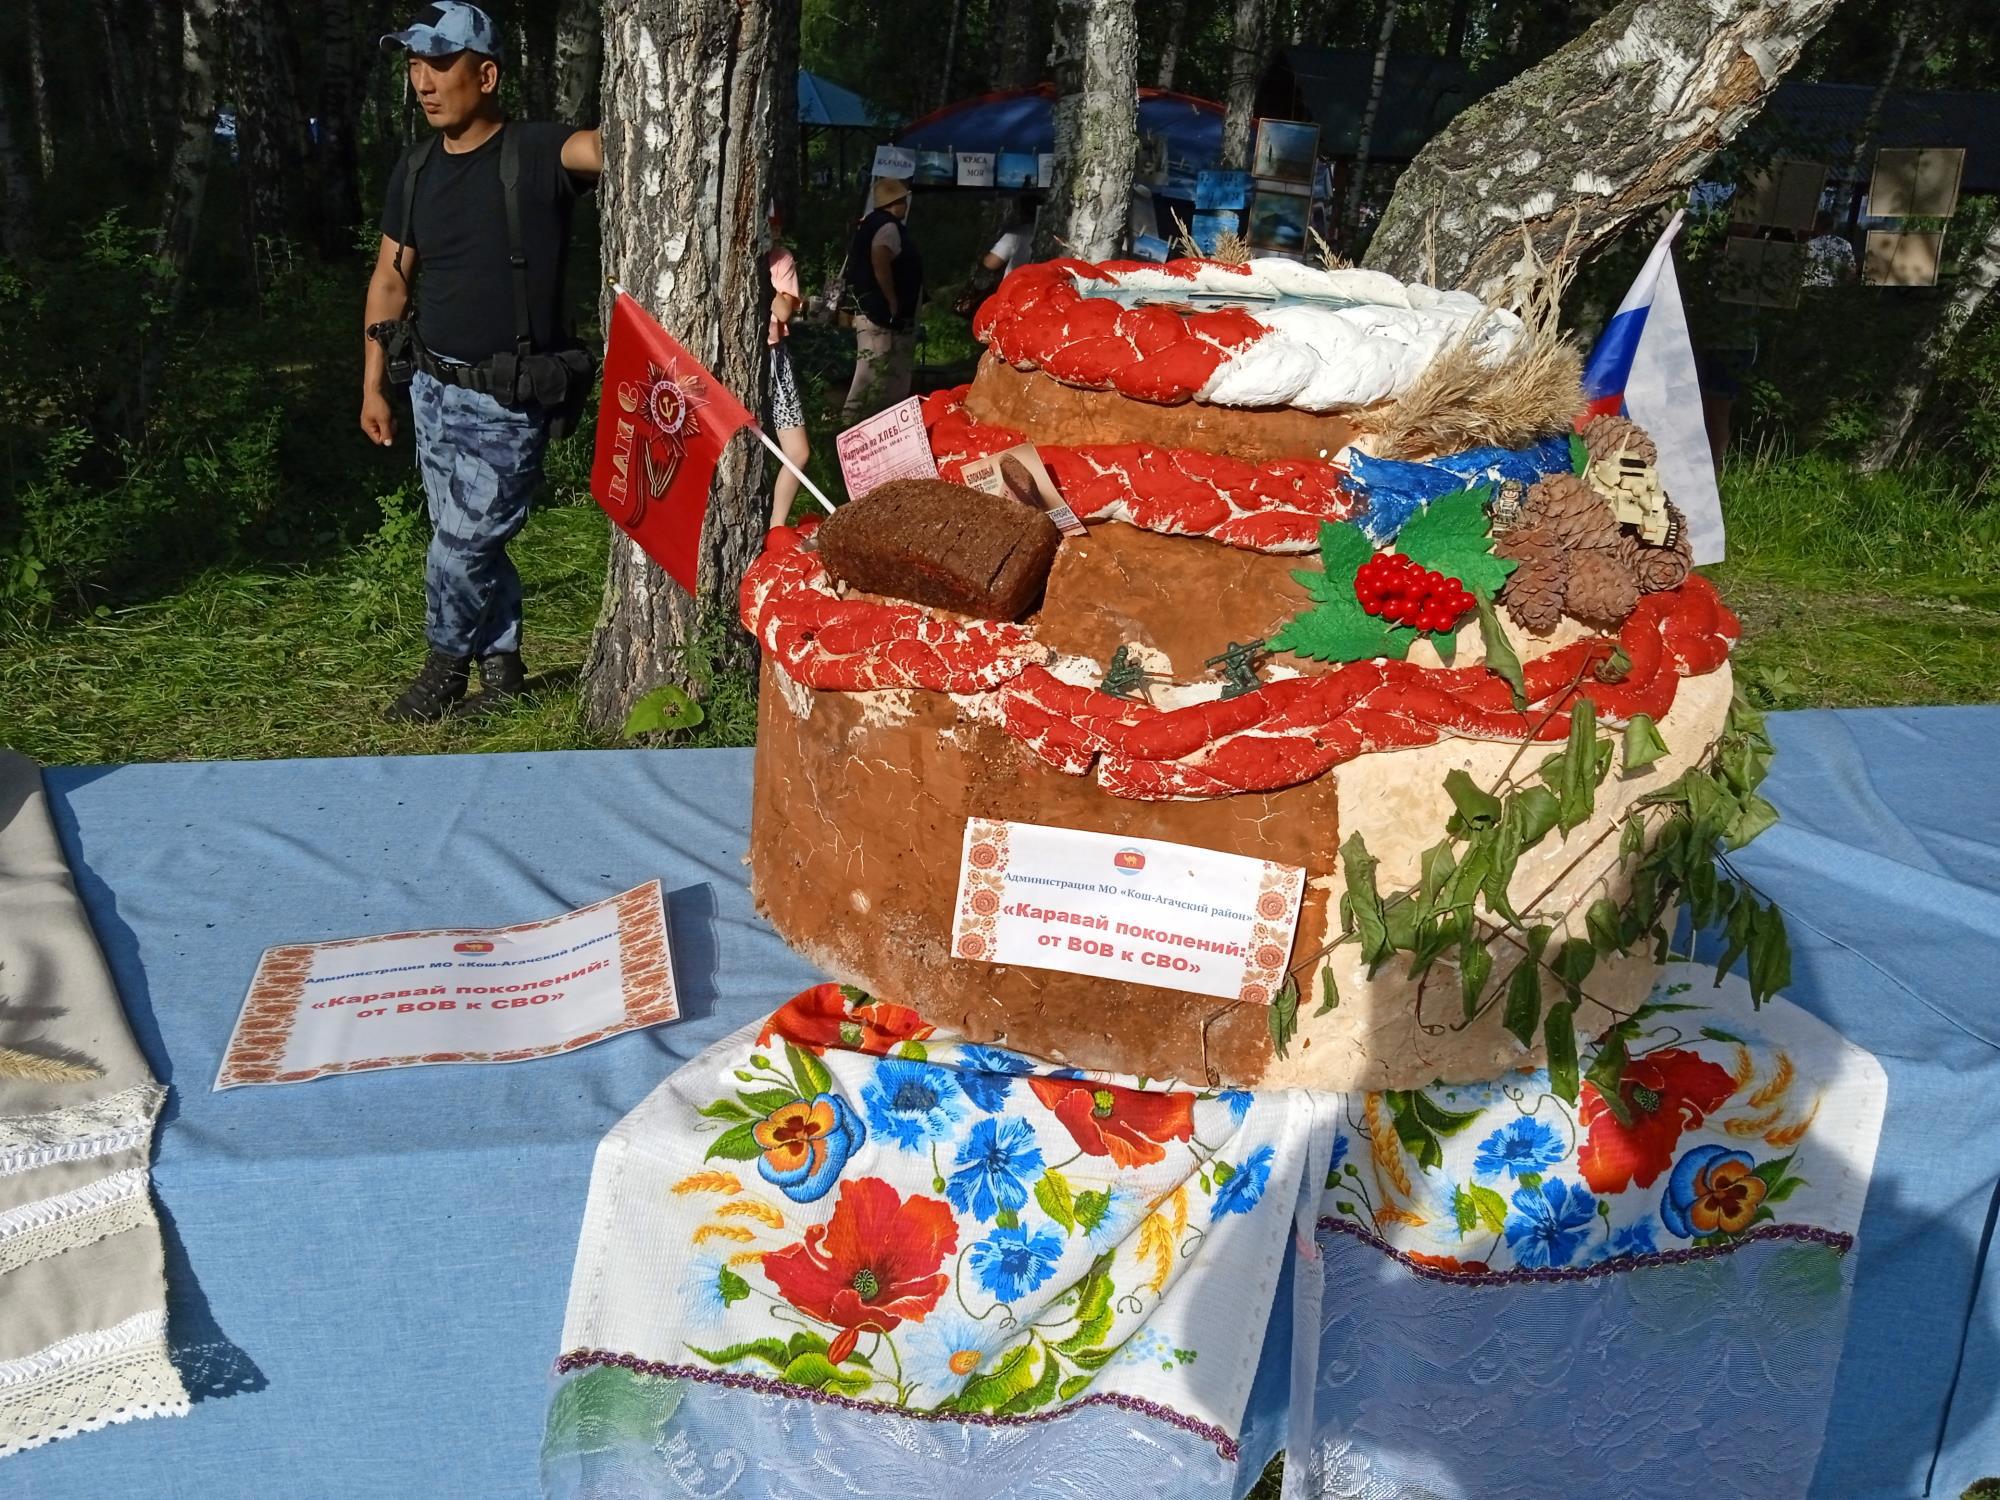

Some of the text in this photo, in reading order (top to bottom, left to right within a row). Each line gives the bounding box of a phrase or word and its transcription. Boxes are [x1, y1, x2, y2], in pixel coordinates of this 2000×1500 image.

[878, 426, 899, 443] ХЛЕБ
[1003, 872, 1253, 921] Администрация МО «Кош-Агачский район»
[1003, 902, 1246, 958] «Каравай поколений:
[1038, 935, 1201, 974] от ВОВ к СВО»
[304, 964, 425, 984] Администрация
[458, 949, 568, 968] «Кош-Агачский
[571, 930, 620, 952] район»
[312, 959, 610, 1010] «Каравай поколений:
[357, 993, 565, 1018] от ВОВ к СВО»
